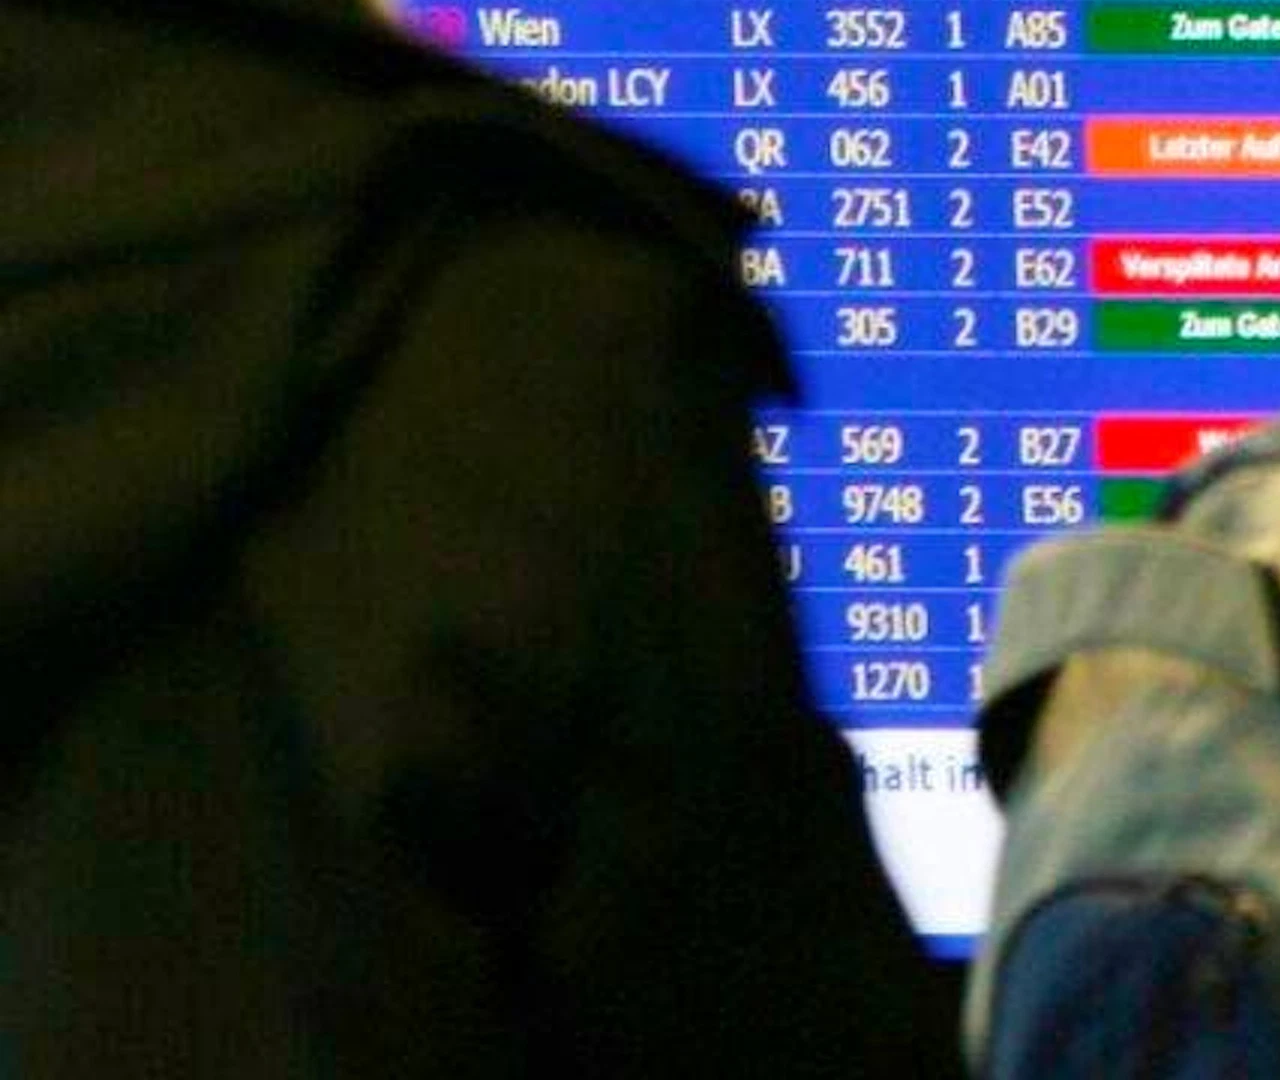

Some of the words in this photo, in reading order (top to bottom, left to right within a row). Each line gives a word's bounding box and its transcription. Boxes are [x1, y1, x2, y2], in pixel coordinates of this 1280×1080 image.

[478, 9, 560, 46] Wien
[732, 10, 772, 47] LX
[827, 10, 906, 48] 3552
[948, 11, 964, 48] 1
[1006, 11, 1066, 48] A85
[1171, 12, 1223, 39] Zum
[735, 129, 785, 175] QR
[831, 129, 891, 167] 062
[949, 129, 970, 167] 2
[1012, 130, 1071, 168] E42
[843, 485, 923, 523] 9748
[960, 486, 981, 523] 2
[1024, 486, 1083, 524] E56
[854, 662, 929, 700] 1270
